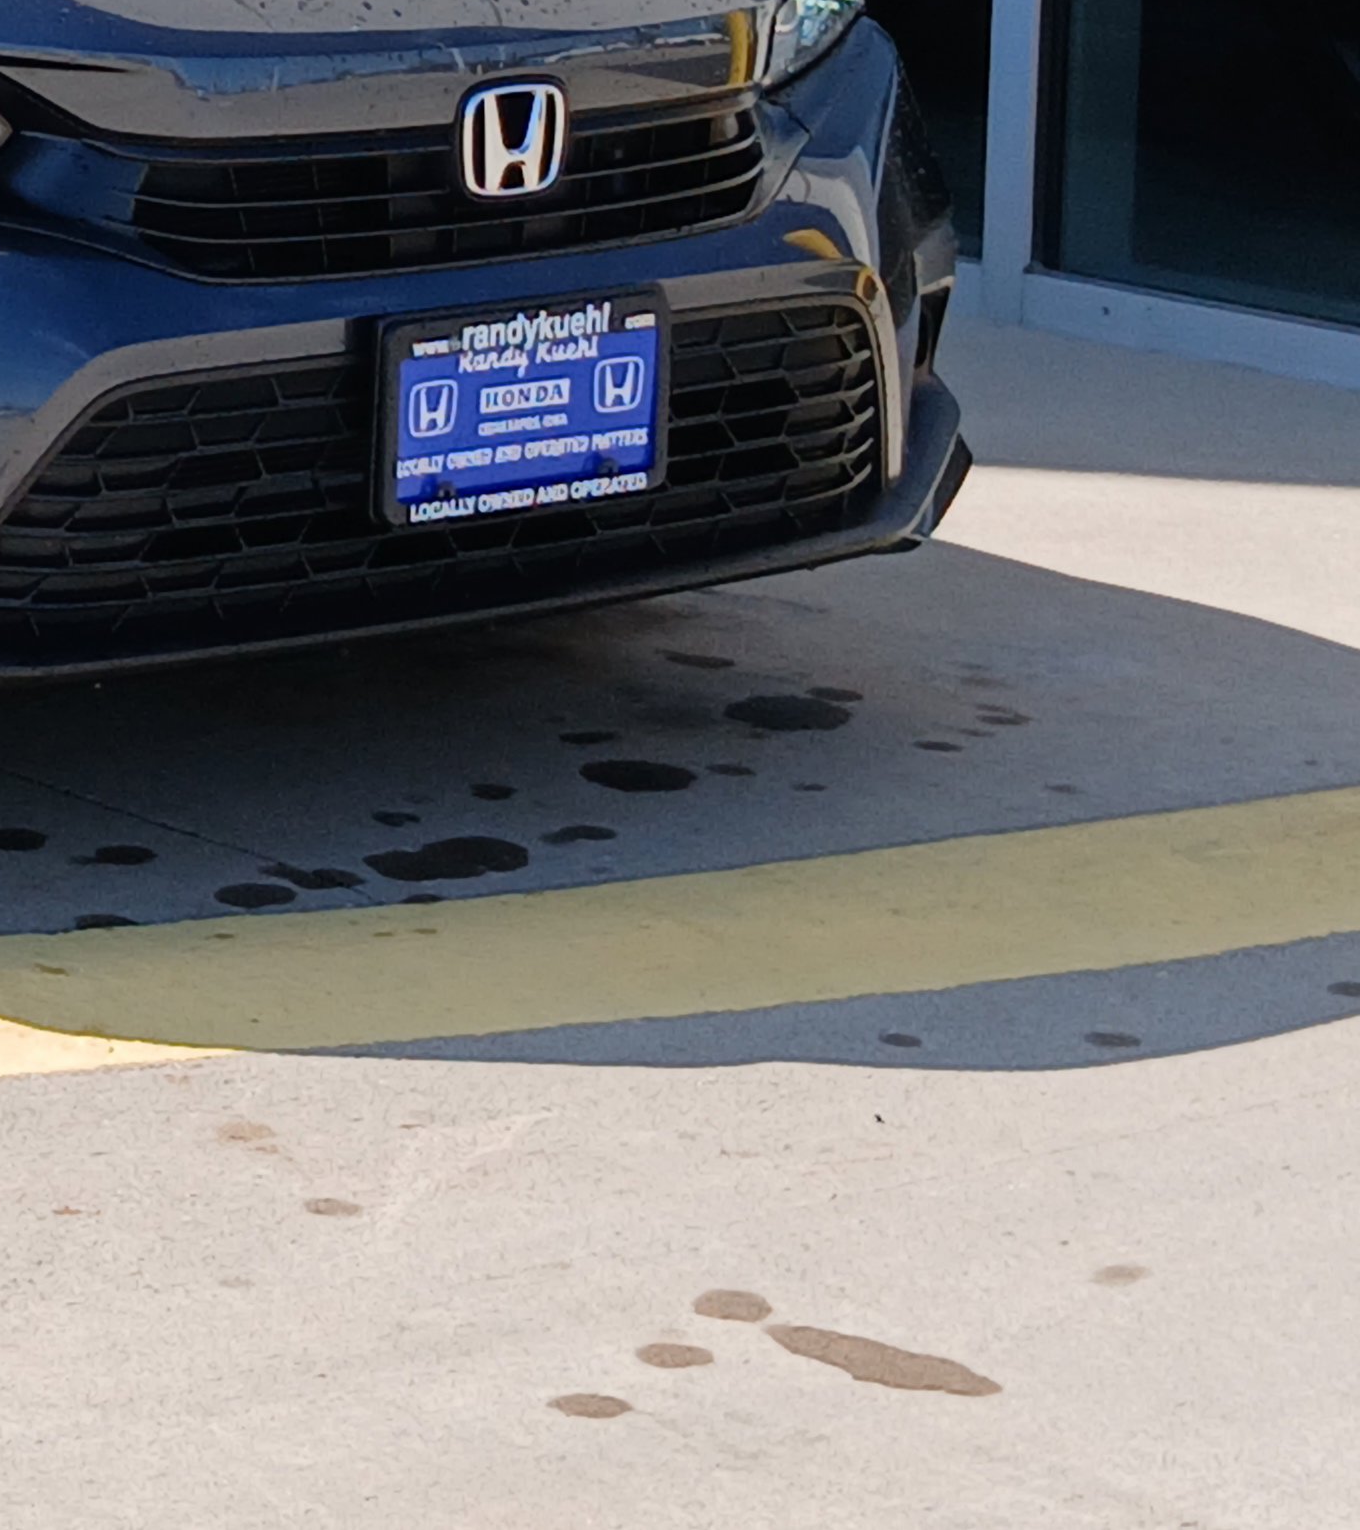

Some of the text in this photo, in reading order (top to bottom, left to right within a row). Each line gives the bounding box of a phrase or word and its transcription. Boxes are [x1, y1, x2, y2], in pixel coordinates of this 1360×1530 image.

[462, 302, 611, 351] randykuehl
[535, 335, 599, 364] Kuehl
[485, 384, 563, 408] HONDA
[410, 495, 477, 523] LOCALLY
